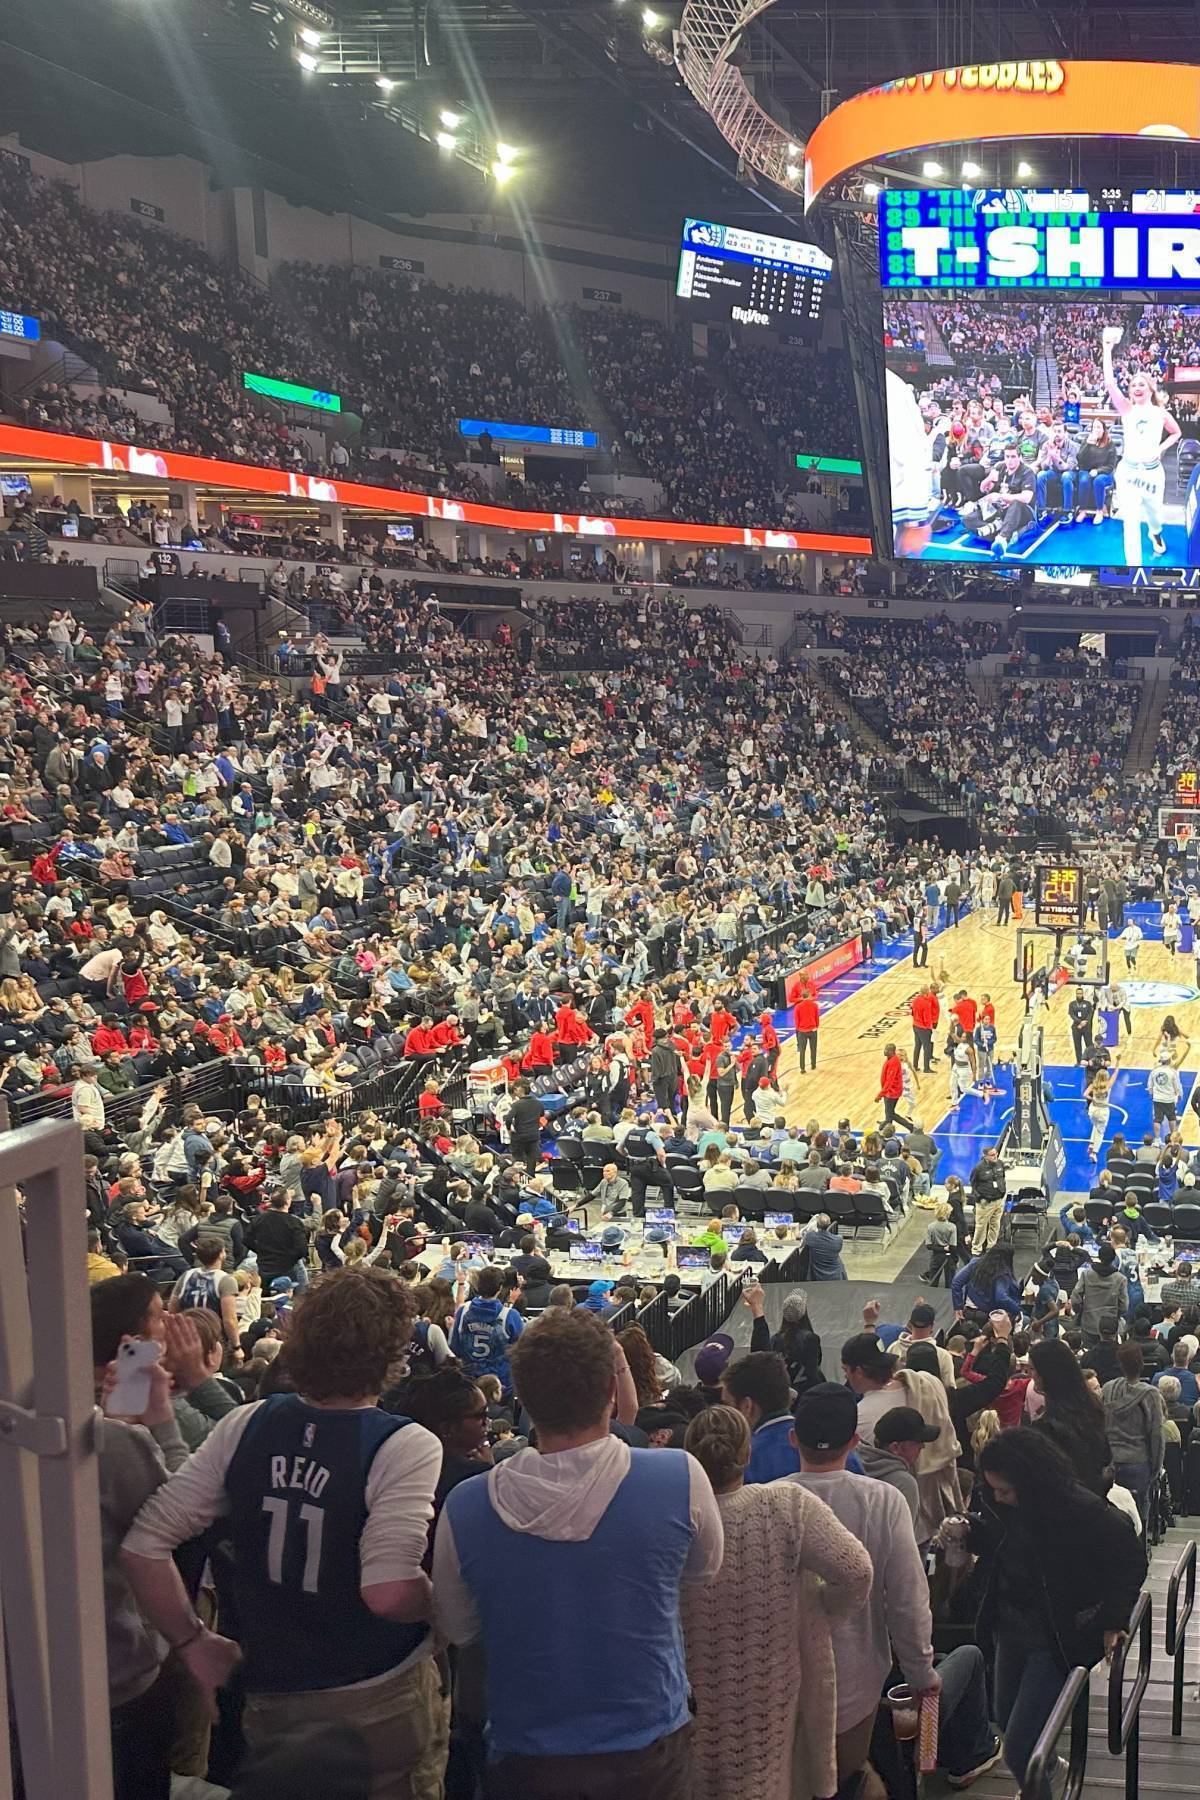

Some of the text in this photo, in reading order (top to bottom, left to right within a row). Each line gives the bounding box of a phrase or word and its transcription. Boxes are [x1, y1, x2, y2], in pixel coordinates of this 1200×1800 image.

[1102, 189, 1121, 198] 3:35
[886, 208, 921, 228] 89
[392, 259, 412, 270] 236
[594, 290, 610, 300] 237
[159, 552, 171, 564] 132
[1178, 780, 1195, 792] 24
[1050, 870, 1076, 882] 3:35
[1045, 882, 1073, 903] 24
[858, 1017, 898, 1040] TARGET
[472, 1335, 490, 1358] 5
[272, 1455, 330, 1498] REID
[262, 1496, 324, 1592] 11
